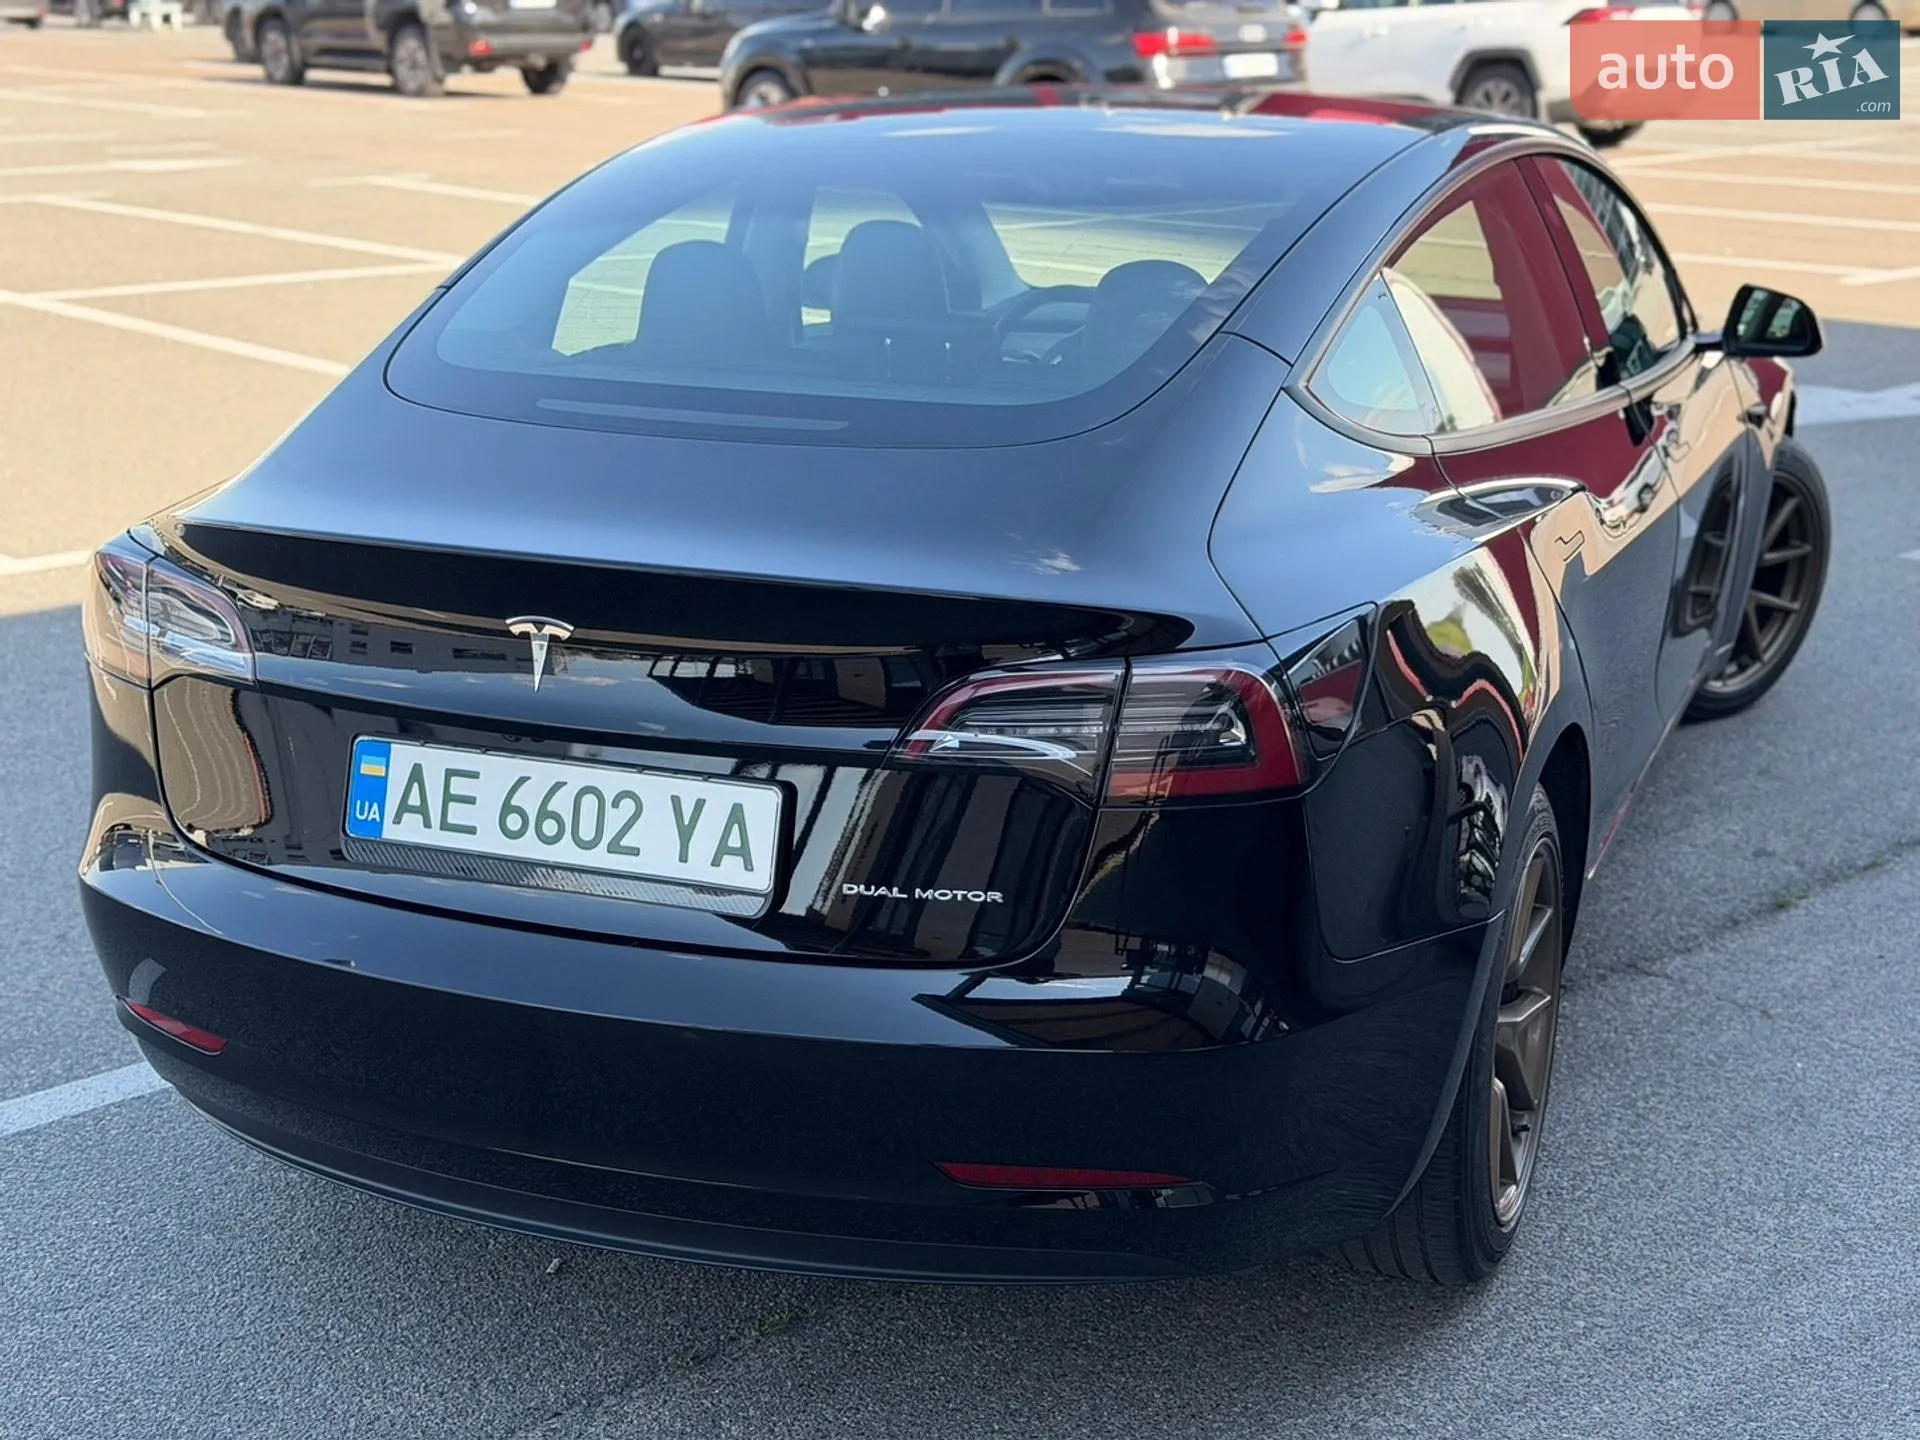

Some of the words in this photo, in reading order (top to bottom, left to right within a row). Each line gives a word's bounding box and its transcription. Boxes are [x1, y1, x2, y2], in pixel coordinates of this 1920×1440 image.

[355, 800, 381, 823] UA
[392, 763, 481, 836] AE
[498, 775, 644, 857] 6602
[670, 794, 755, 872] YA
[842, 883, 908, 899] DUAL
[914, 887, 1004, 903] MOTOR
